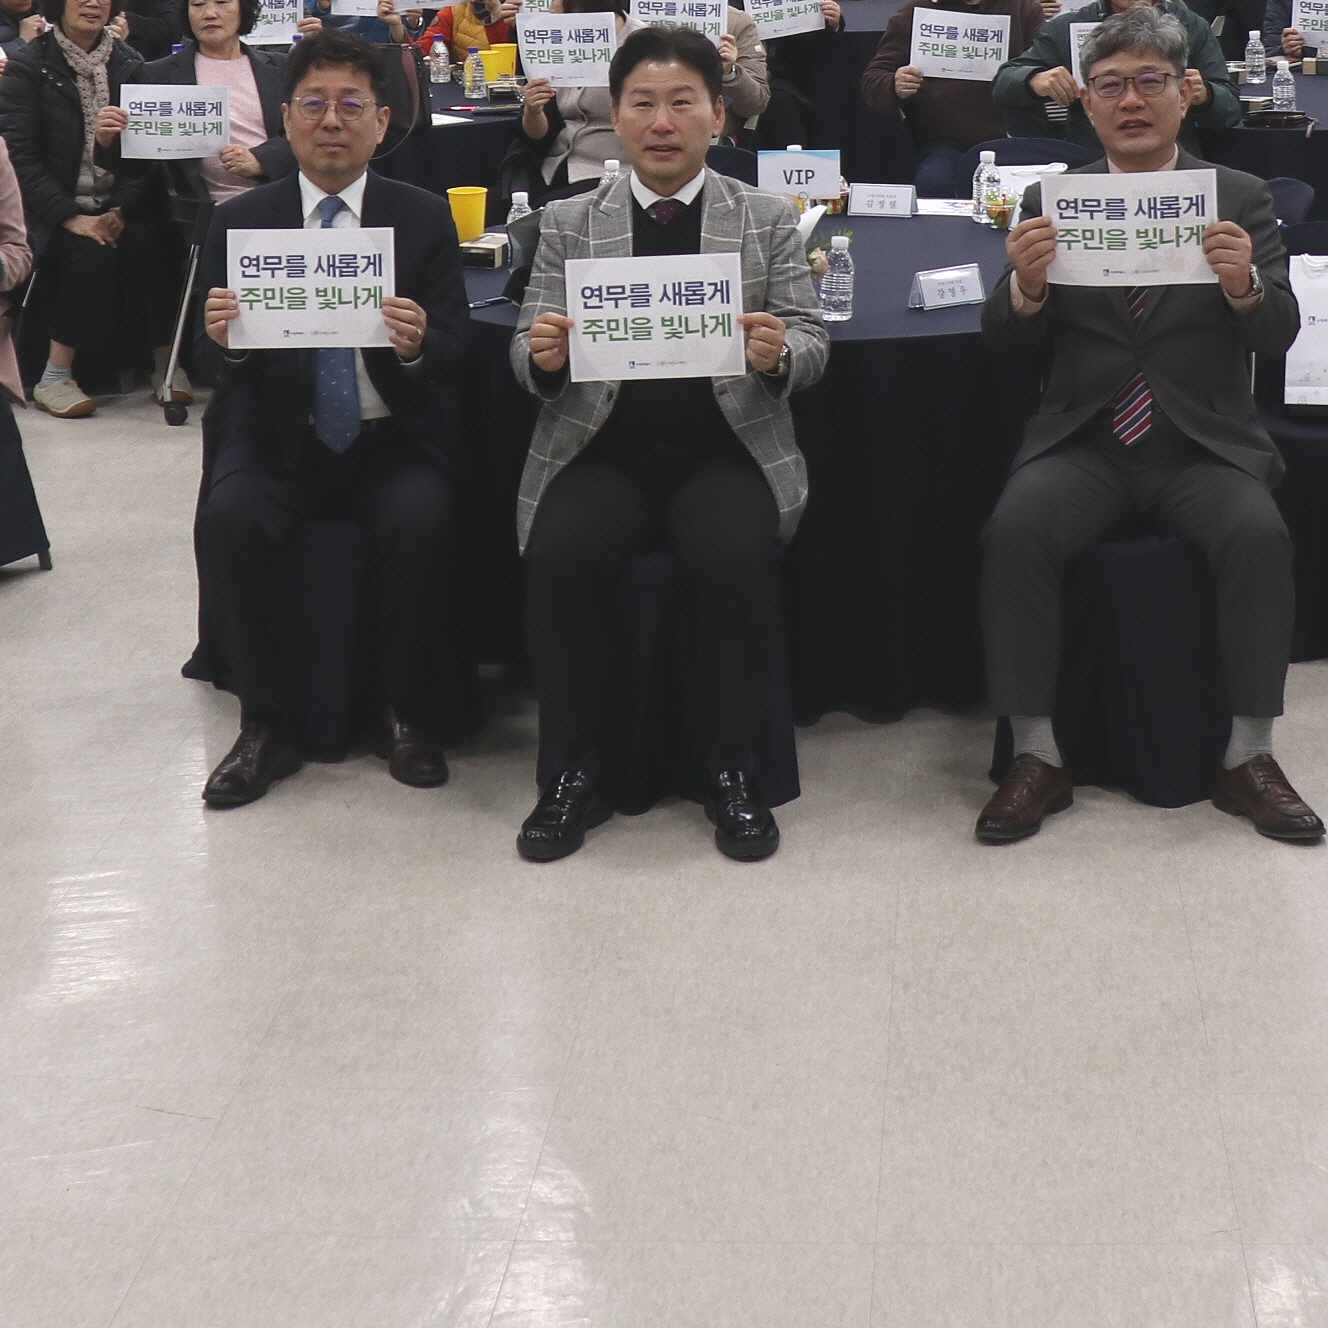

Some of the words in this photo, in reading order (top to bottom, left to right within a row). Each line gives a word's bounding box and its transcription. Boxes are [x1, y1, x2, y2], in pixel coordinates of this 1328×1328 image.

[637, 0, 677, 16] 연무를
[682, 2, 721, 17] 새롭게
[752, 10, 784, 24] 주민을
[786, 2, 820, 15] 빛나게
[262, 12, 298, 25] 빛나게
[523, 28, 563, 43] 연무를
[567, 27, 610, 43] 새롭게
[919, 23, 959, 39] 연무를
[962, 27, 1003, 43] 새롭게
[525, 48, 565, 63] 주민을
[569, 47, 611, 63] 빛나게
[917, 41, 958, 58] 주민을
[962, 44, 1002, 60] 빛나게
[129, 100, 173, 116] 연무를
[178, 100, 223, 116] 새롭게
[128, 120, 173, 135] 주민을
[178, 120, 223, 136] 빛나게
[782, 169, 815, 185] VIP
[1055, 195, 1128, 220] 연무를
[1133, 192, 1206, 220] 새롭게
[1055, 225, 1128, 250] 주민을
[1134, 223, 1206, 249] 빛나게
[238, 253, 308, 279] 연무를
[312, 252, 383, 278] 새롭게
[238, 285, 308, 311] 주민을
[314, 283, 383, 311] 빛나게
[580, 282, 652, 309] 연무를
[658, 278, 731, 305] 새롭게
[581, 315, 653, 342] 주민을
[660, 312, 732, 339] 빛나게
